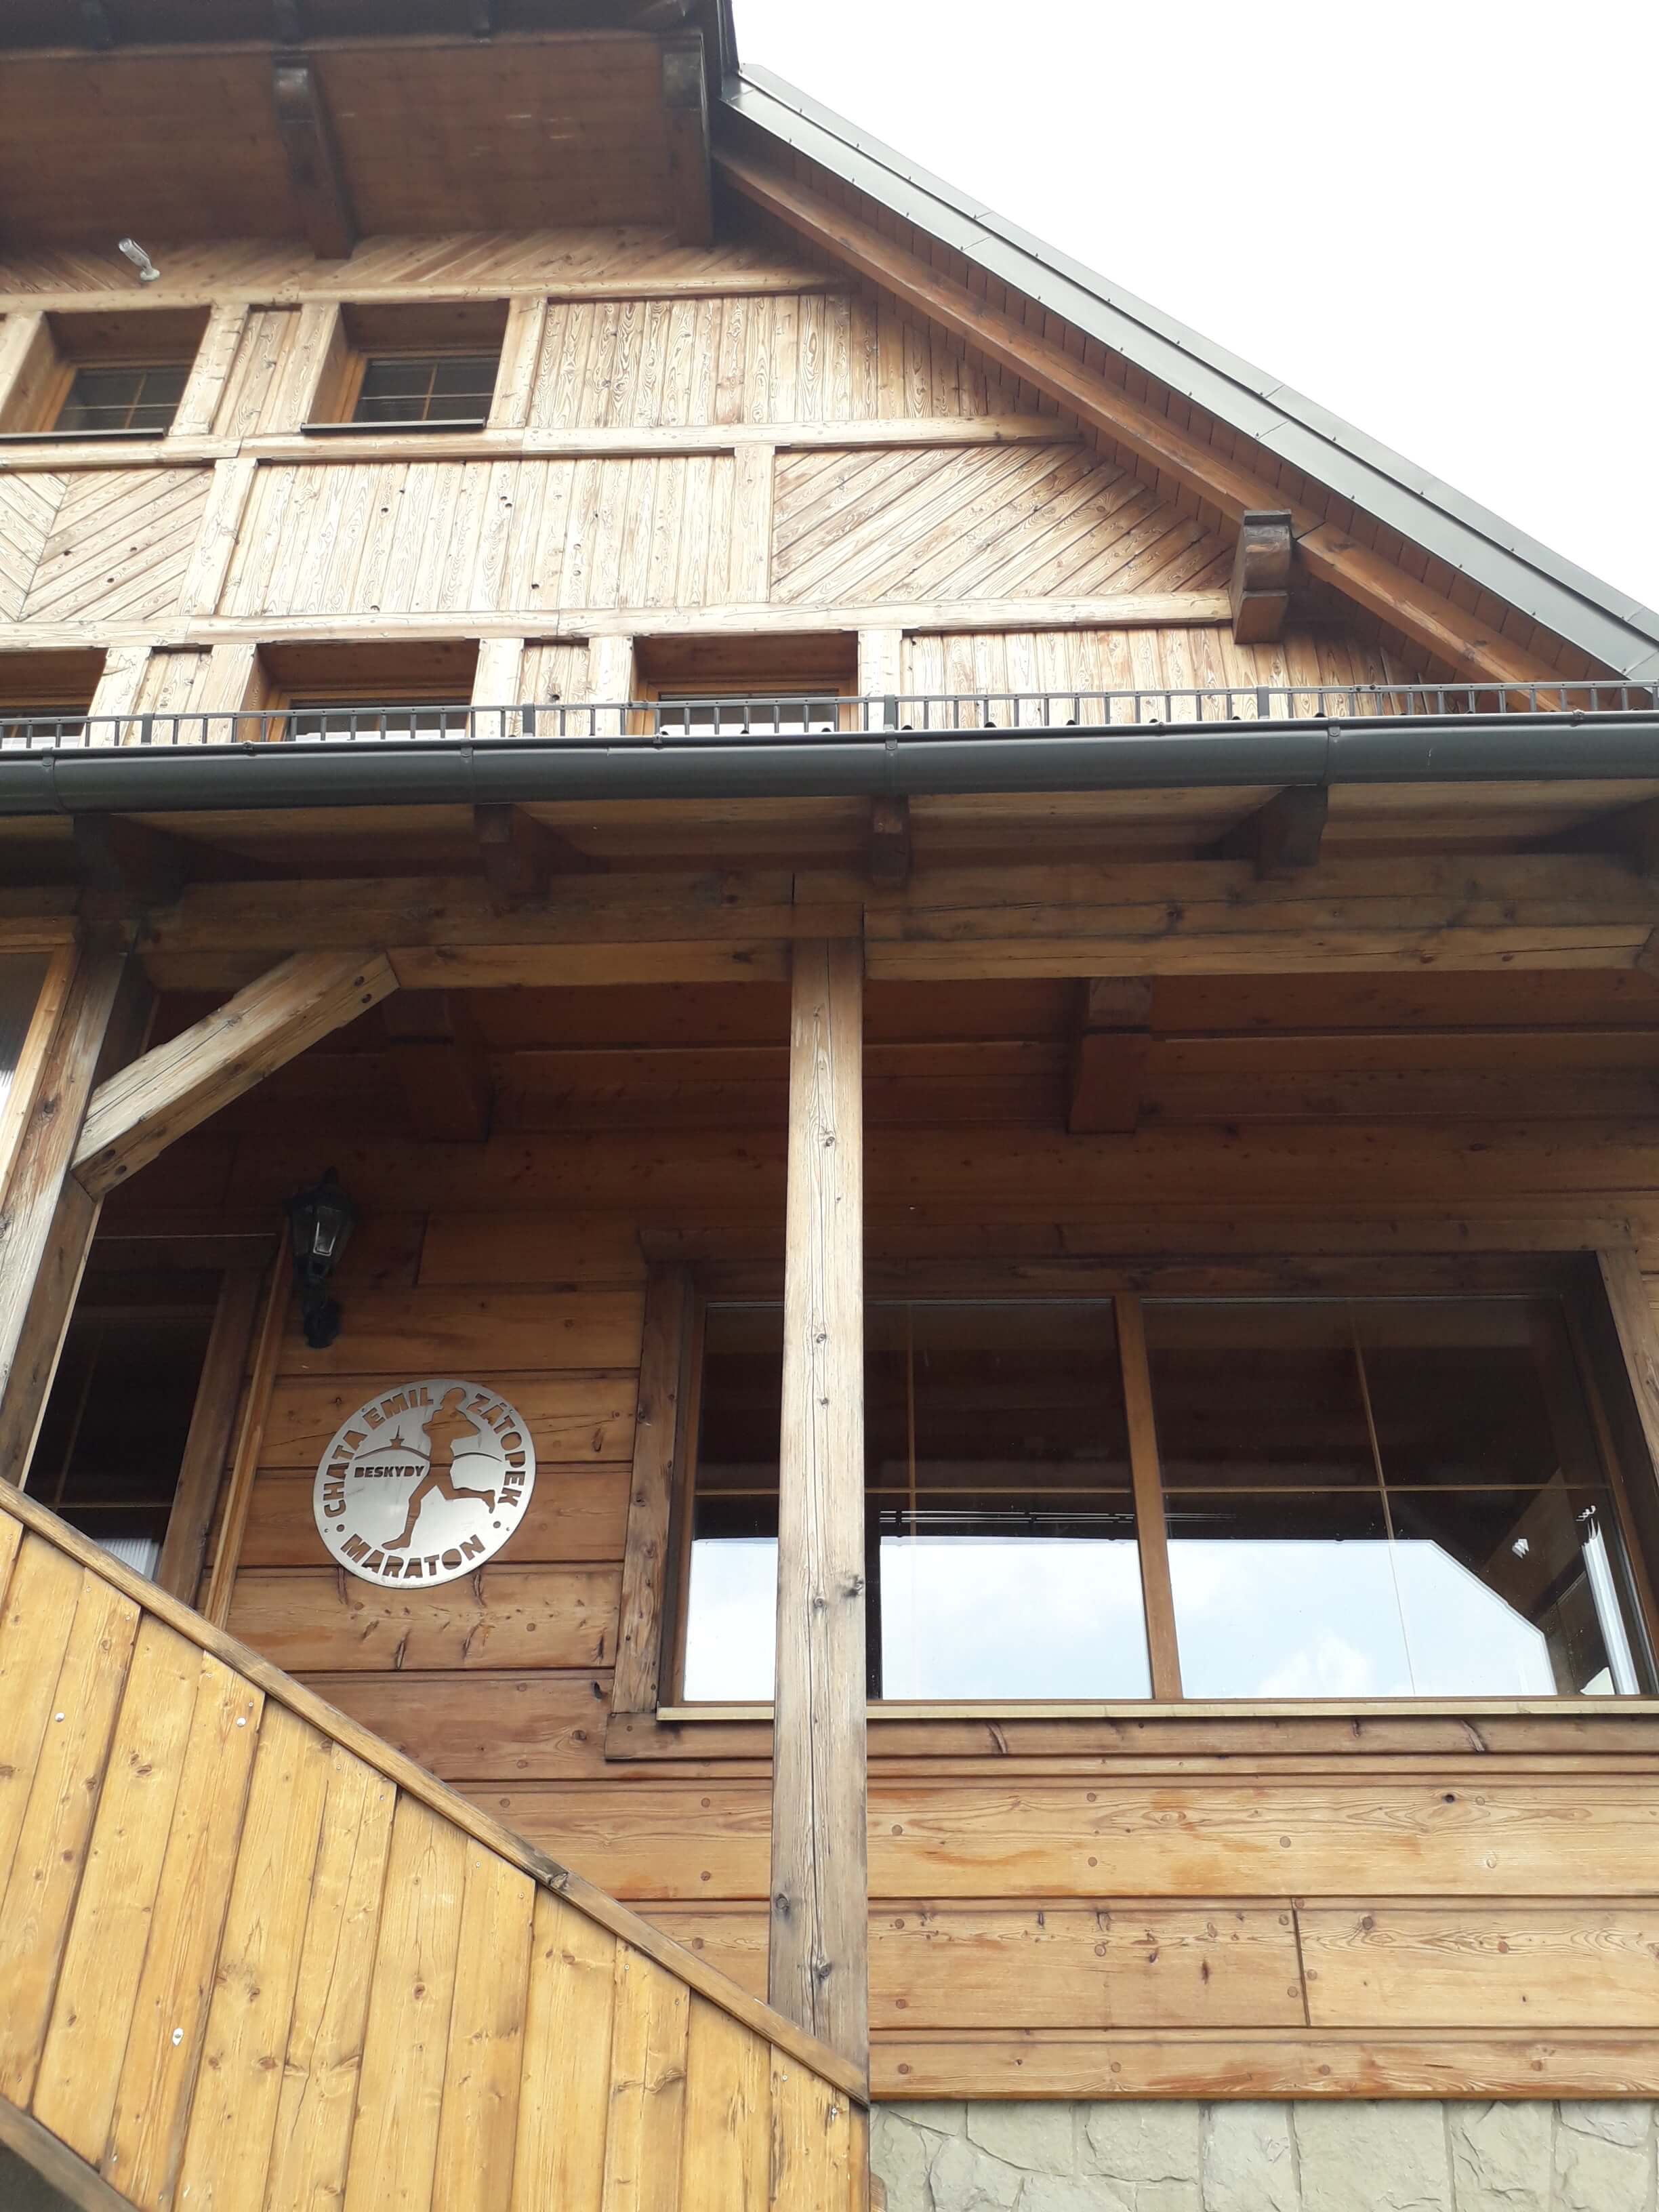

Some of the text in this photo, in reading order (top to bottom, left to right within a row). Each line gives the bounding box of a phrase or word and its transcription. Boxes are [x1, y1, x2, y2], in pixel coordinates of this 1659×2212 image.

[323, 1387, 526, 1517] CHATA EMIL ZÁTOPEK
[354, 1466, 424, 1478] BESKYDY
[340, 1534, 486, 1578] MARATON
